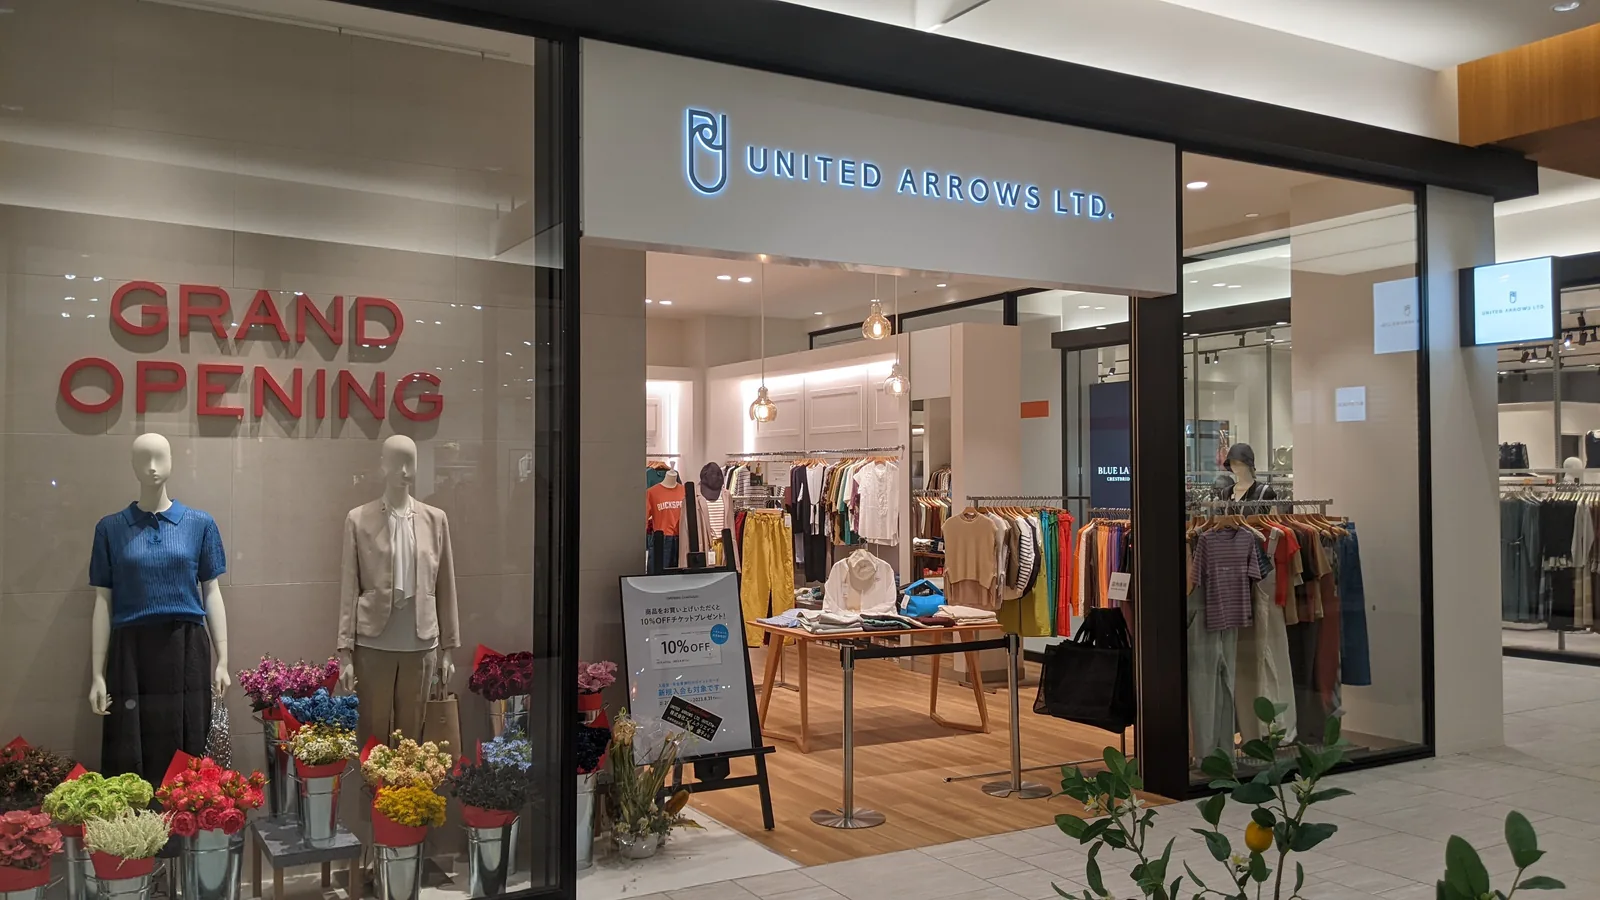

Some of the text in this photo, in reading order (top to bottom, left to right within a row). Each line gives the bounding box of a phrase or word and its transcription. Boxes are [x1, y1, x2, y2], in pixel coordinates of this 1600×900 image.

[746, 145, 1115, 220] UNITED ARROWS LTD.
[111, 281, 404, 346] GRAND
[59, 357, 444, 421] OPENING
